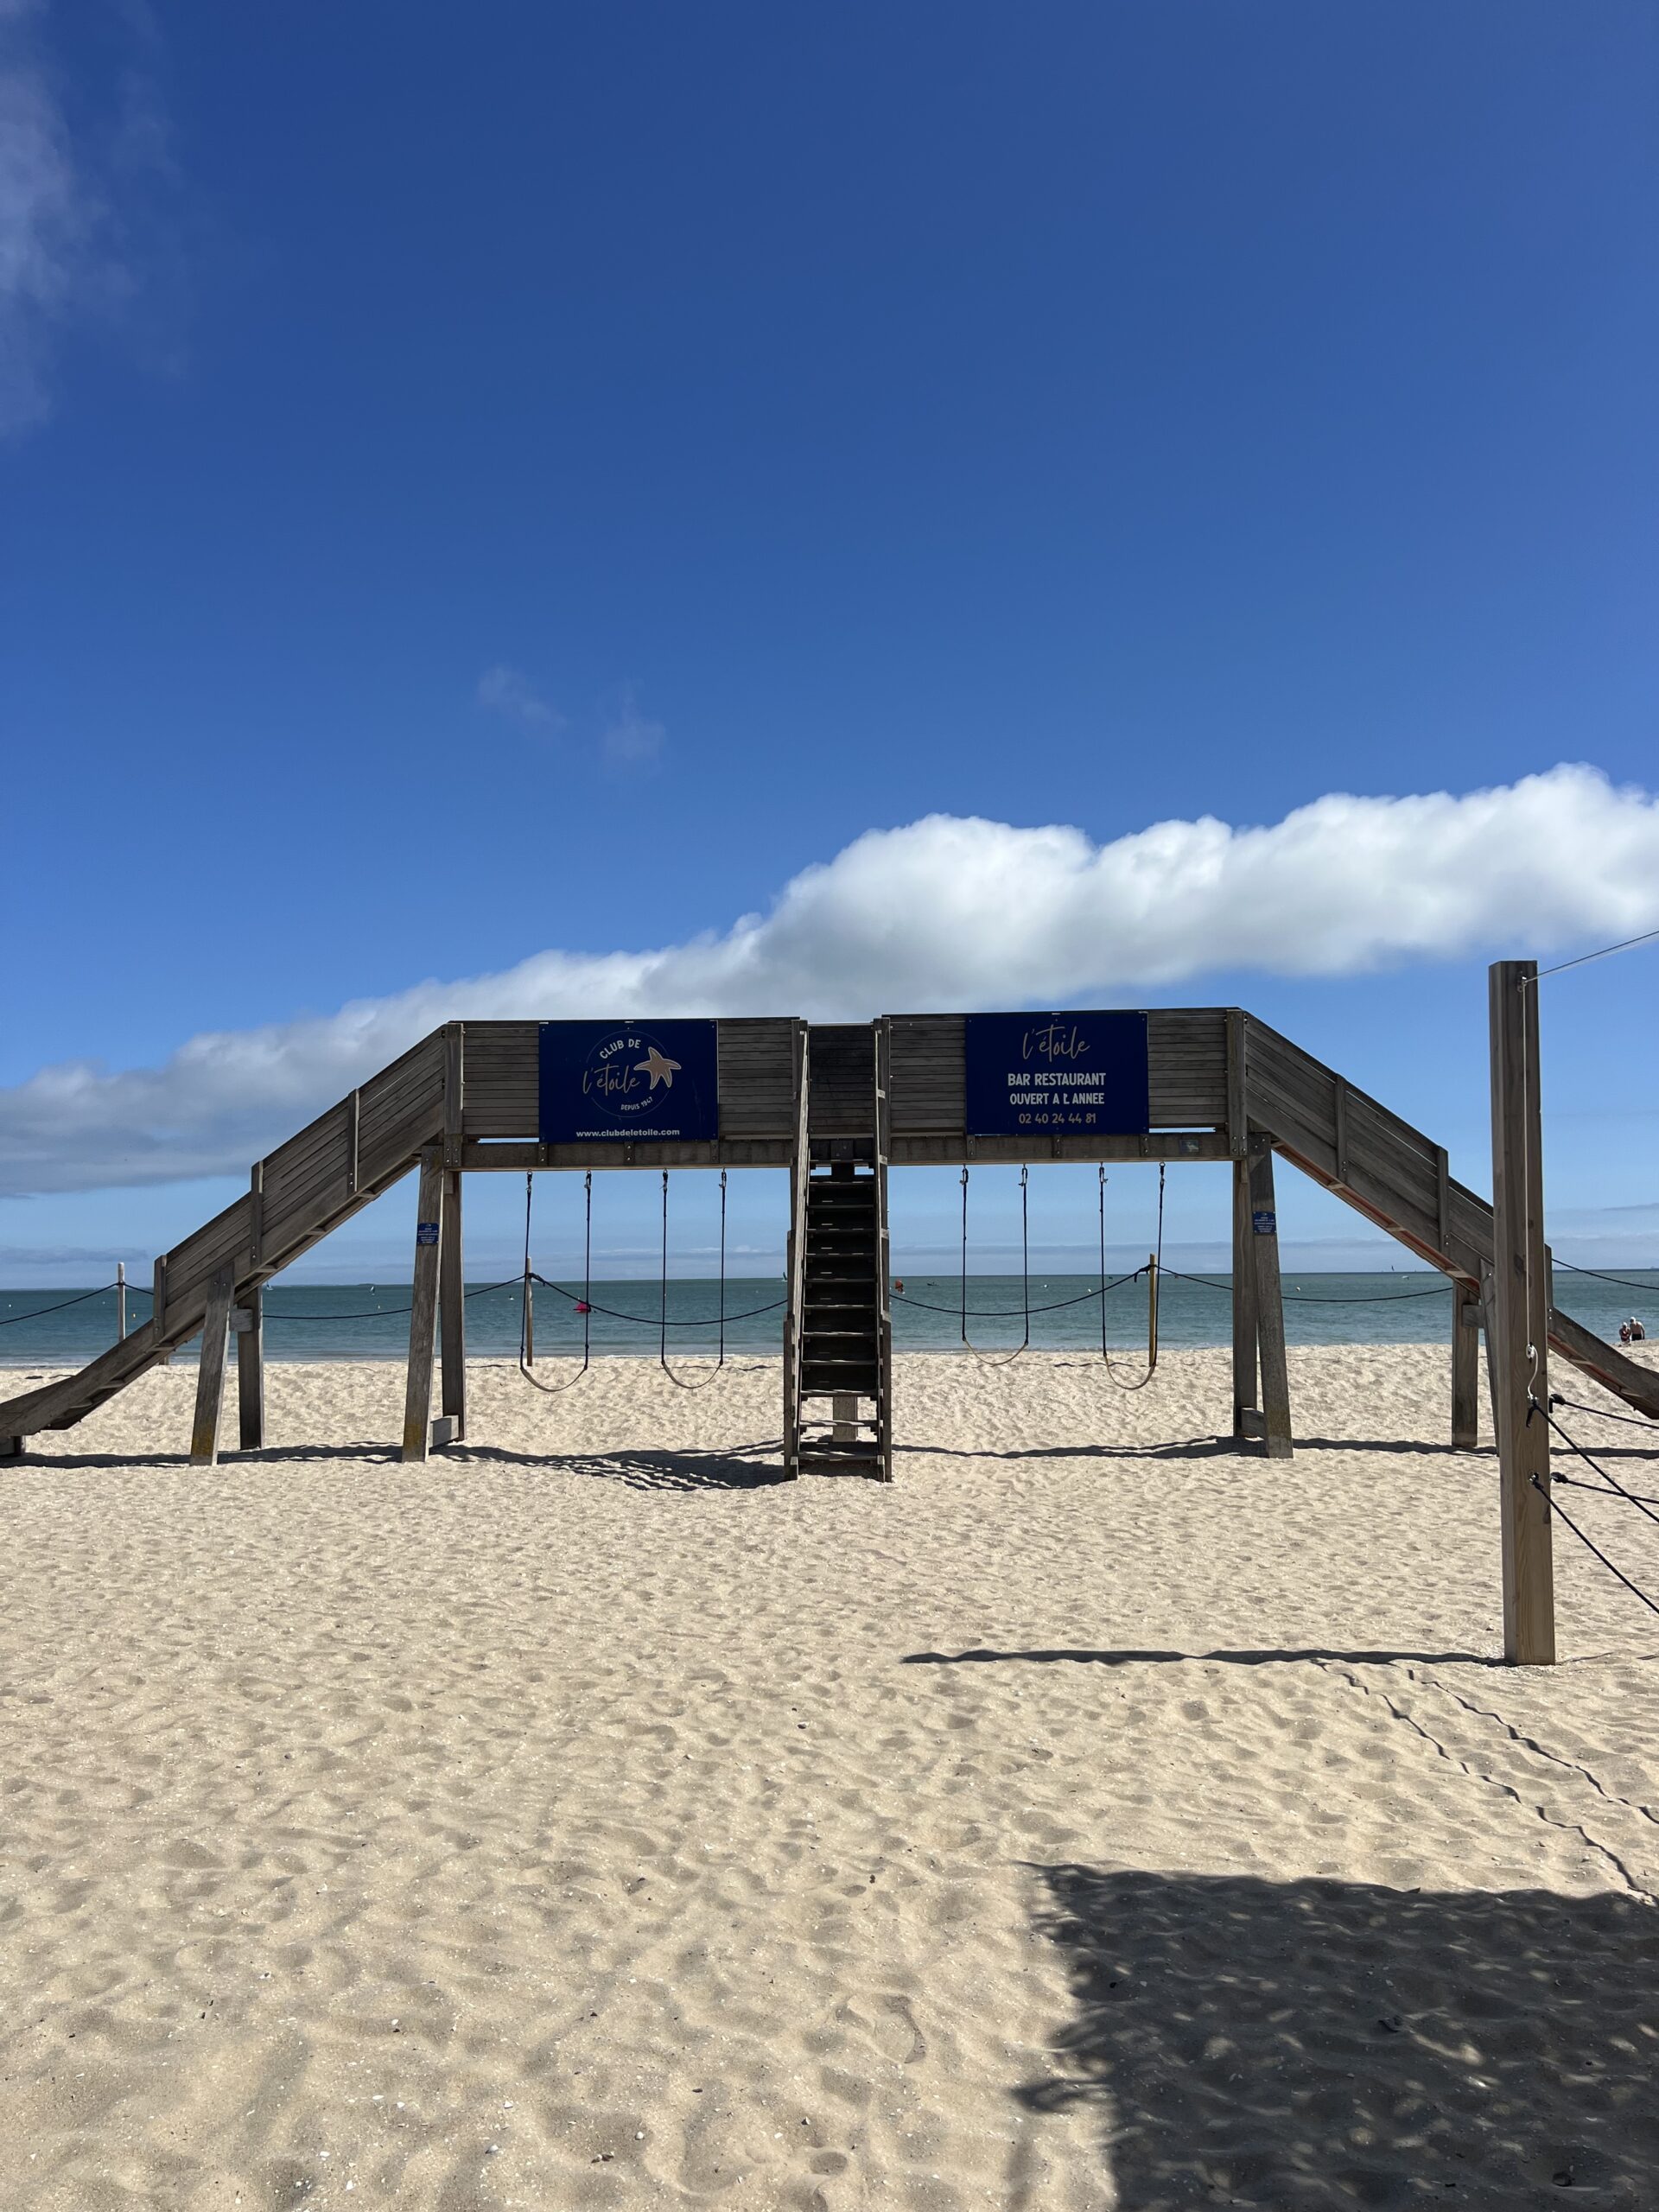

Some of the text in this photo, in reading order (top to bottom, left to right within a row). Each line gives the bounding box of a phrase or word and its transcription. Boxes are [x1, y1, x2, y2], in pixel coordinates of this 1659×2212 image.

[599, 1039, 641, 1058] CLUB DE
[1007, 1072, 1106, 1086] BAR RESTAURANT
[1009, 1093, 1049, 1104] OUVERT
[1052, 1093, 1060, 1104] A
[1018, 1113, 1096, 1124] 02 40 24 44 81
[575, 1128, 680, 1137] www.clubdeletoile.com
